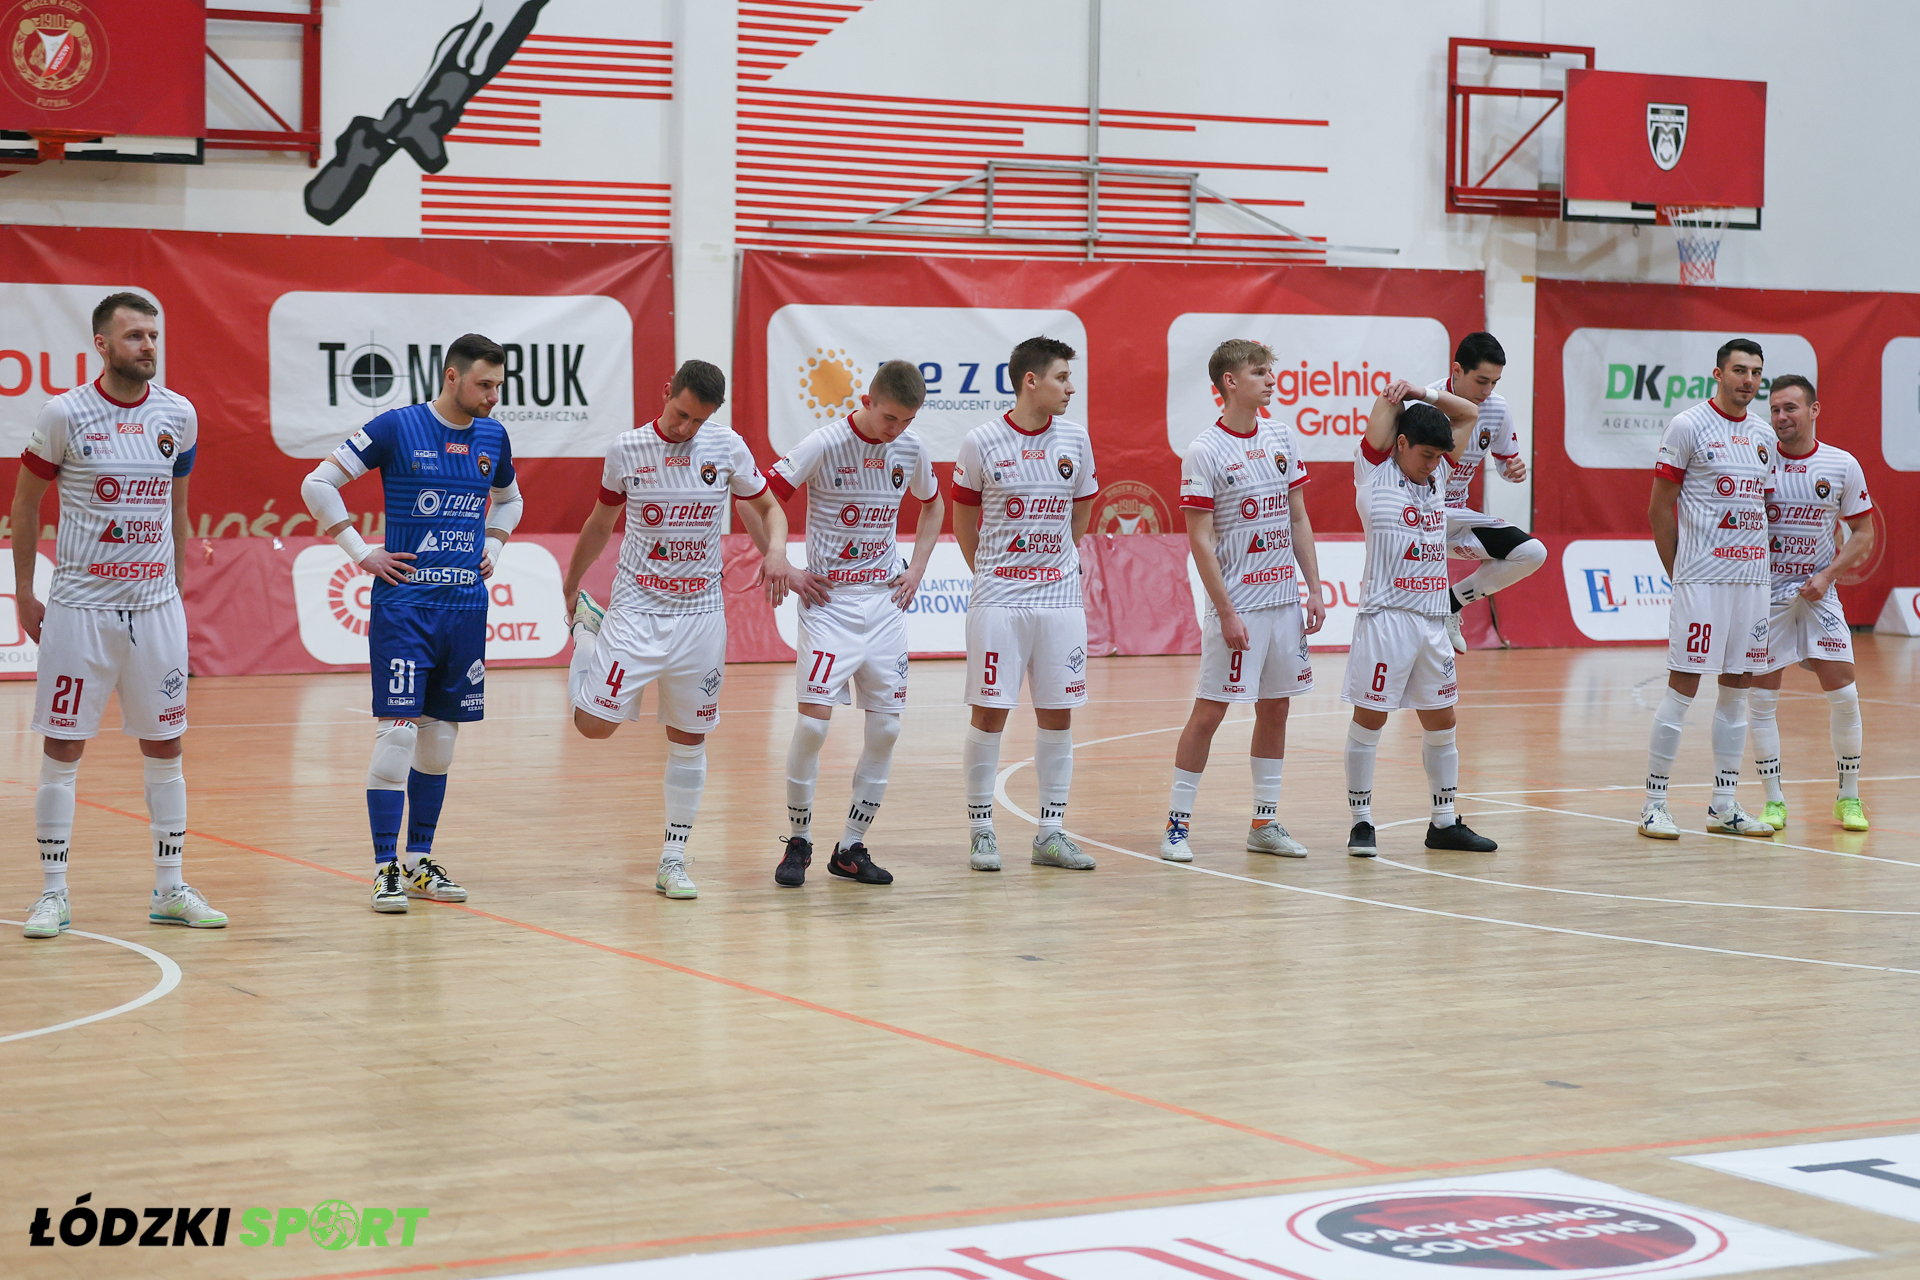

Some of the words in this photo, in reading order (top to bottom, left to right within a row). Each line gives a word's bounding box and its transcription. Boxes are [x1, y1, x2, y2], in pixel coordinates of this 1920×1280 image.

[40, 14, 65, 28] 1910
[318, 342, 588, 407] TOMRUK
[1272, 360, 1391, 406] gielnia
[923, 400, 991, 411] PRODUCENT
[994, 400, 1017, 411] UPO
[492, 411, 589, 422] KSOGRAFICZNA
[1296, 407, 1369, 436] Grab
[127, 477, 170, 496] reiter
[445, 492, 485, 511] reiter
[1030, 496, 1068, 513] reiter
[670, 502, 716, 520] reiter
[865, 505, 898, 521] reite
[1786, 504, 1826, 521] reiter
[126, 518, 163, 531] TORUŃ
[127, 533, 162, 544] PLAZA
[440, 529, 475, 543] TORUŃ
[668, 537, 707, 551] TORUŃ
[1028, 531, 1062, 544] TORUŃ
[1783, 536, 1817, 546] TORUŃ
[441, 542, 474, 553] PLAZA
[1028, 544, 1061, 554] PLAZA
[1267, 538, 1291, 551] PLAZA
[1784, 546, 1816, 555] PLAZA
[671, 552, 706, 561] PLAZA
[1714, 547, 1765, 560] autoSTER
[90, 563, 166, 579] autoSTER
[405, 568, 477, 585] autoSTER
[828, 569, 887, 582] autoSTER
[995, 567, 1063, 582] autoSTER
[1771, 563, 1816, 574] utoSTER
[637, 575, 709, 592] autoSTER
[1395, 577, 1447, 591] autoSTER
[1634, 575, 1672, 594] ELS
[1687, 623, 1712, 654] 28
[1817, 641, 1847, 649] RUSTICO
[808, 650, 836, 684] 77
[984, 651, 999, 685] 5
[1229, 650, 1243, 683] 9
[389, 658, 416, 694] 31
[606, 660, 626, 698] 4
[1372, 662, 1388, 692] 6
[51, 675, 84, 715] 21
[460, 697, 485, 708] RUSTIC
[1341, 1207, 1620, 1244] PACKAGING
[1392, 1219, 1662, 1258] SOLUTIONS
